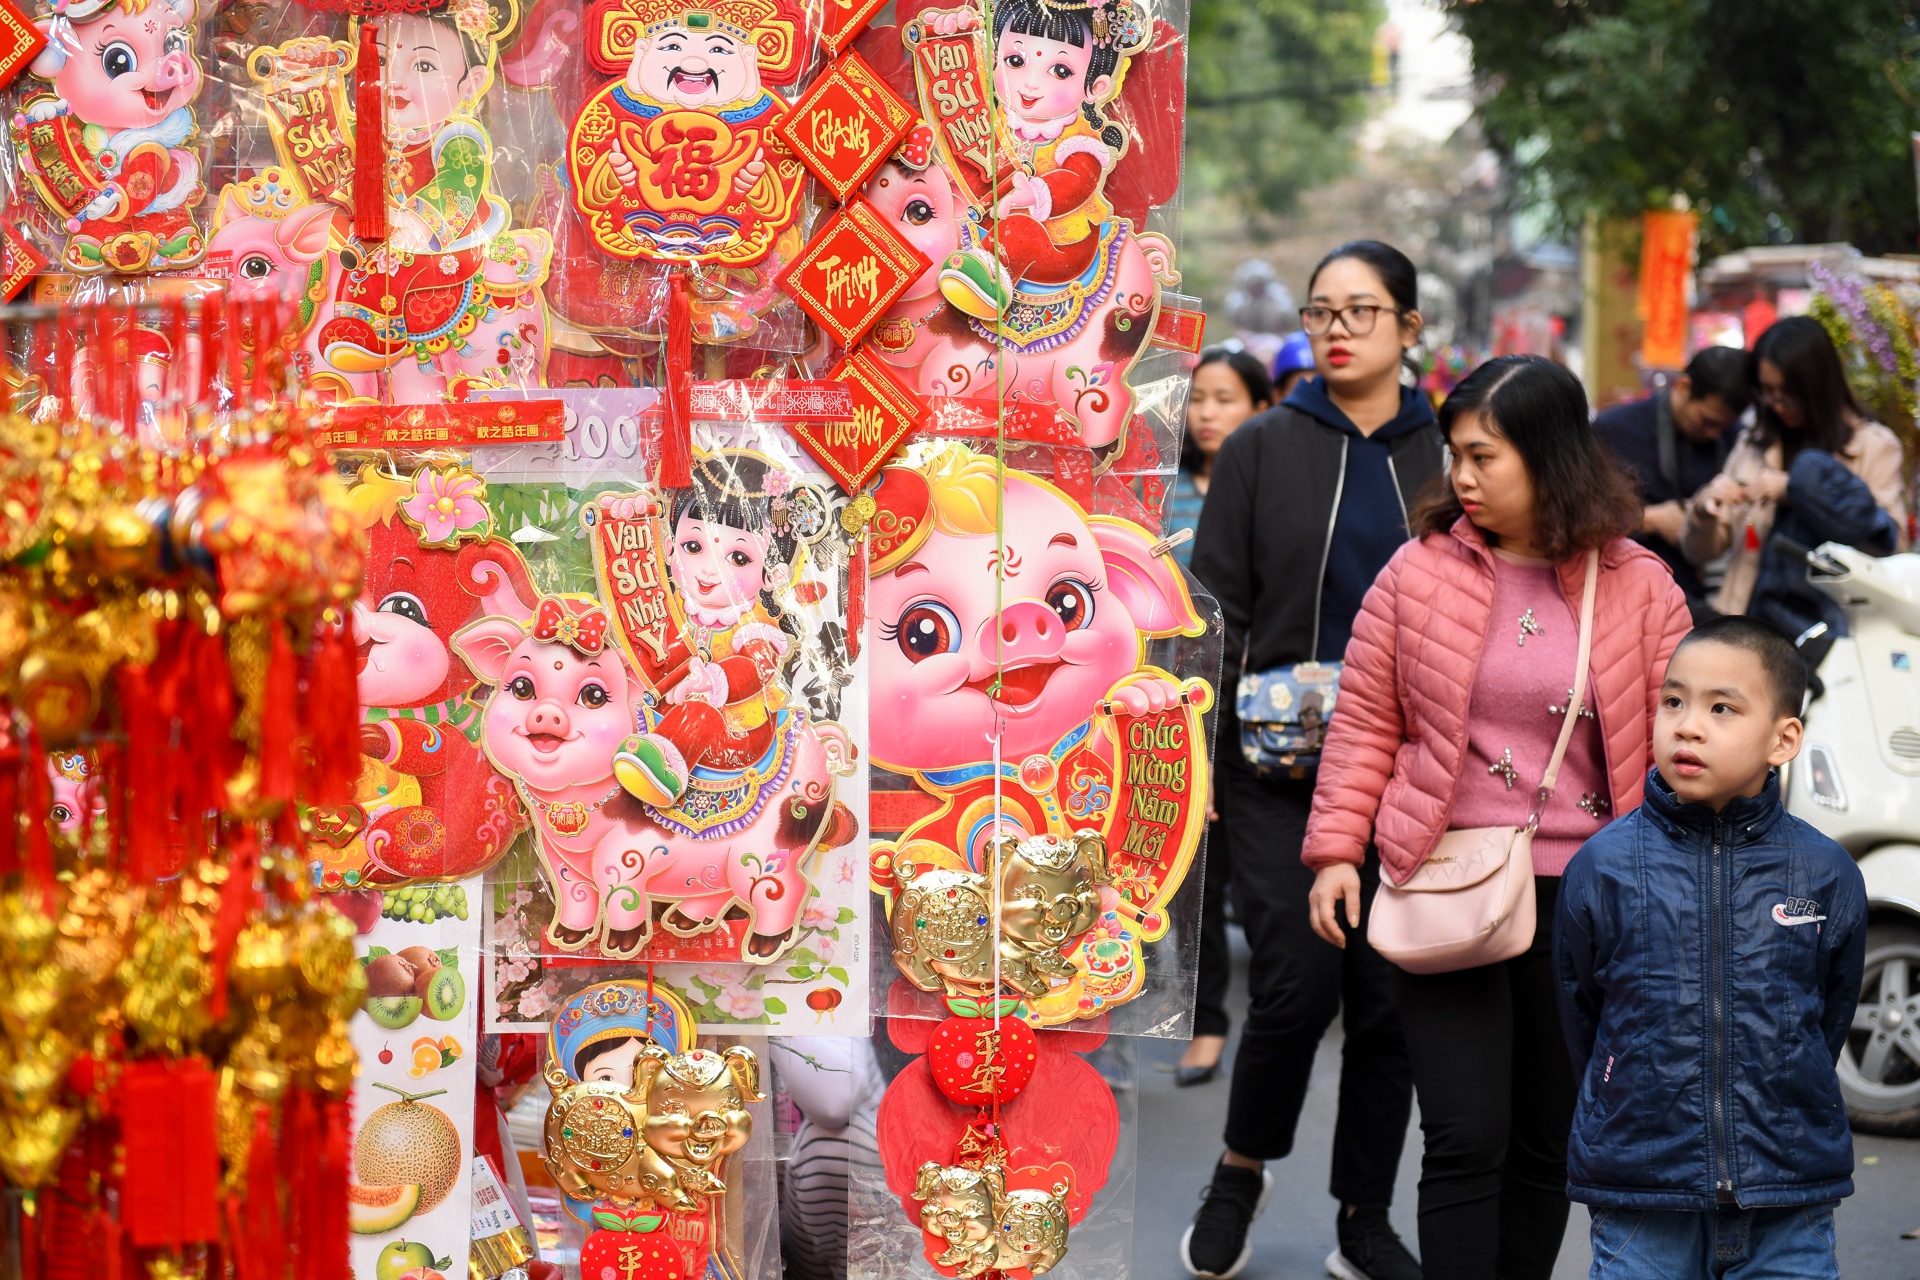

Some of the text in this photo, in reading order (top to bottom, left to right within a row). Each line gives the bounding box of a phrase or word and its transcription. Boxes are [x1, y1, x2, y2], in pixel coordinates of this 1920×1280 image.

[932, 72, 980, 116] Sự
[946, 108, 993, 151] Như
[301, 147, 356, 194] Như
[649, 119, 720, 202] 福
[476, 423, 539, 440] 秋之梦年画
[611, 554, 659, 597] Sự
[621, 591, 668, 632] Như
[636, 621, 669, 664] Ý
[1129, 716, 1184, 752] Chúc
[1126, 752, 1187, 793] Mừng
[1126, 785, 1180, 829] Năm
[1121, 820, 1167, 862] Mới
